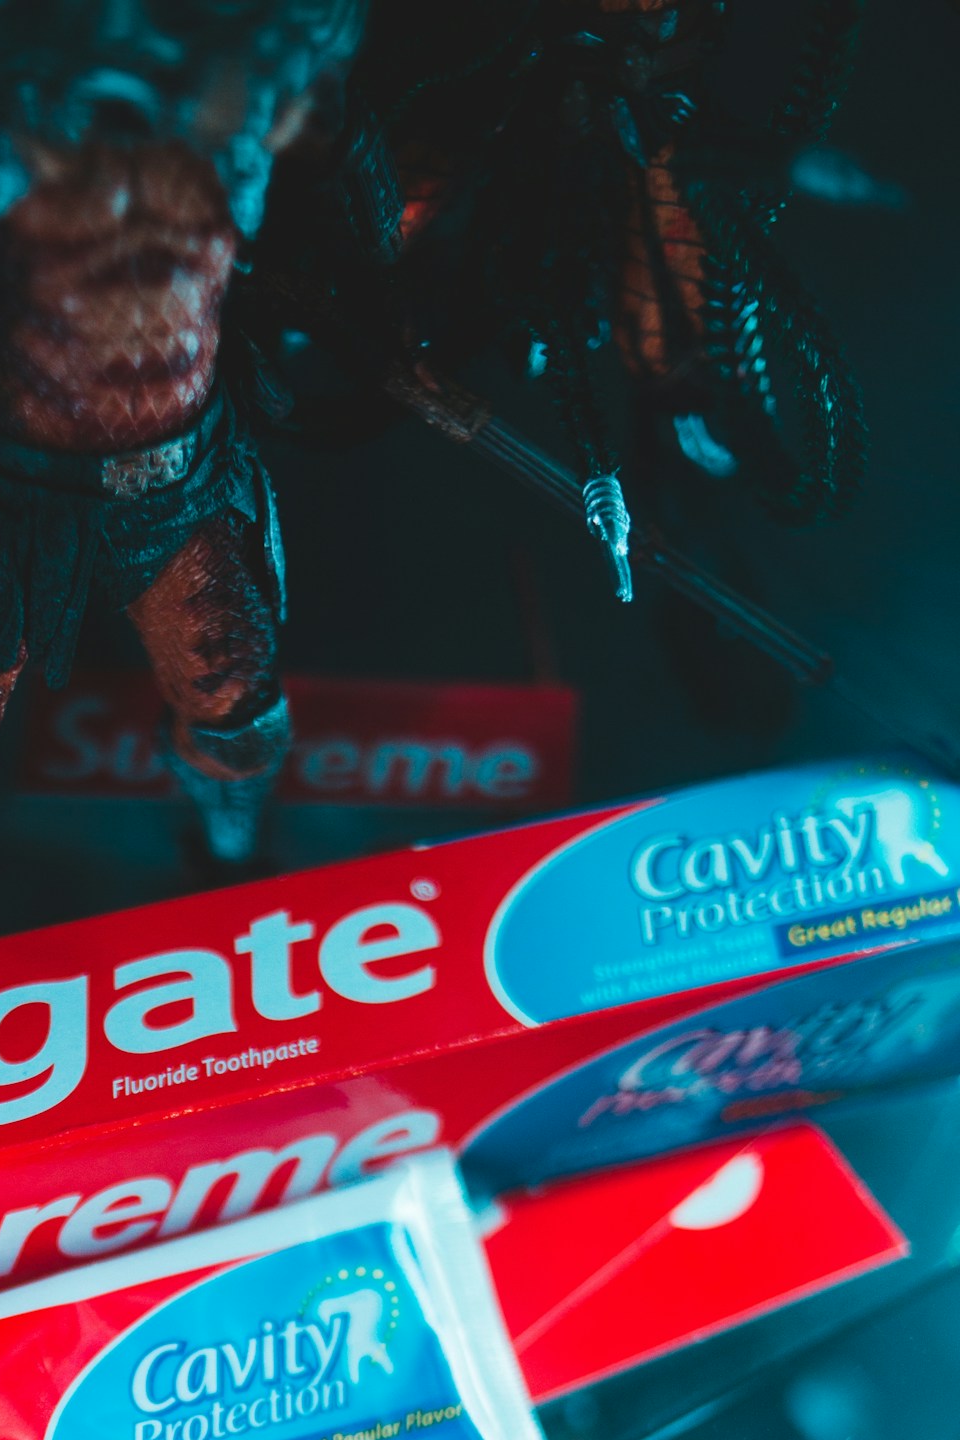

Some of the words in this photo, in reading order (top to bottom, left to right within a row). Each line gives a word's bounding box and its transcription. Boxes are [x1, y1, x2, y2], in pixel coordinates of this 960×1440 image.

[41, 699, 537, 797] Sueme
[631, 803, 874, 900] Cavity
[641, 866, 886, 944] Protection
[788, 915, 857, 947] Great
[861, 896, 952, 930] Regular
[112, 1063, 199, 1100] Fluoride
[202, 1036, 320, 1079] Toothpaste
[132, 1314, 343, 1413] Cavity
[405, 1404, 463, 1431] Flavor
